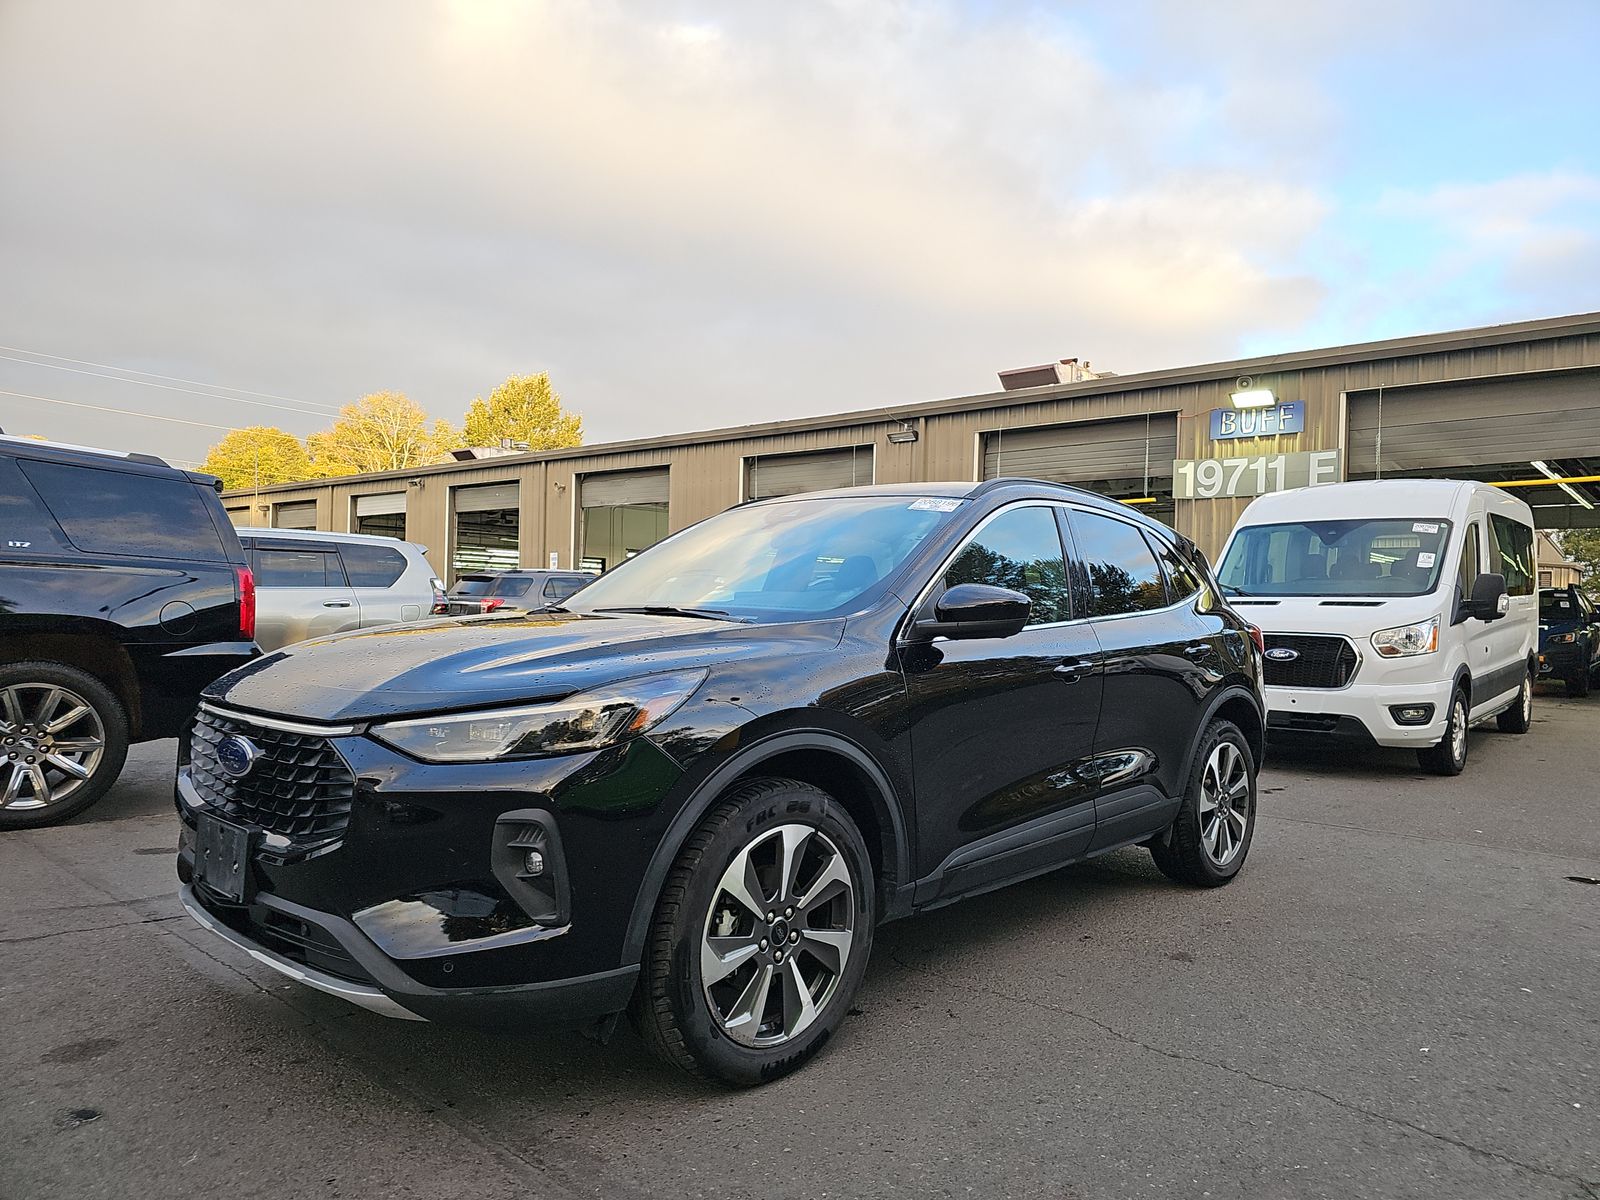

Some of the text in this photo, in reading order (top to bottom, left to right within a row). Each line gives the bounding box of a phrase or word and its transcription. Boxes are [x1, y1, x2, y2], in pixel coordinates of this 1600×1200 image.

[1220, 403, 1294, 435] BUFF
[1177, 451, 1337, 497] 19711 E
[8, 540, 31, 548] LTZ
